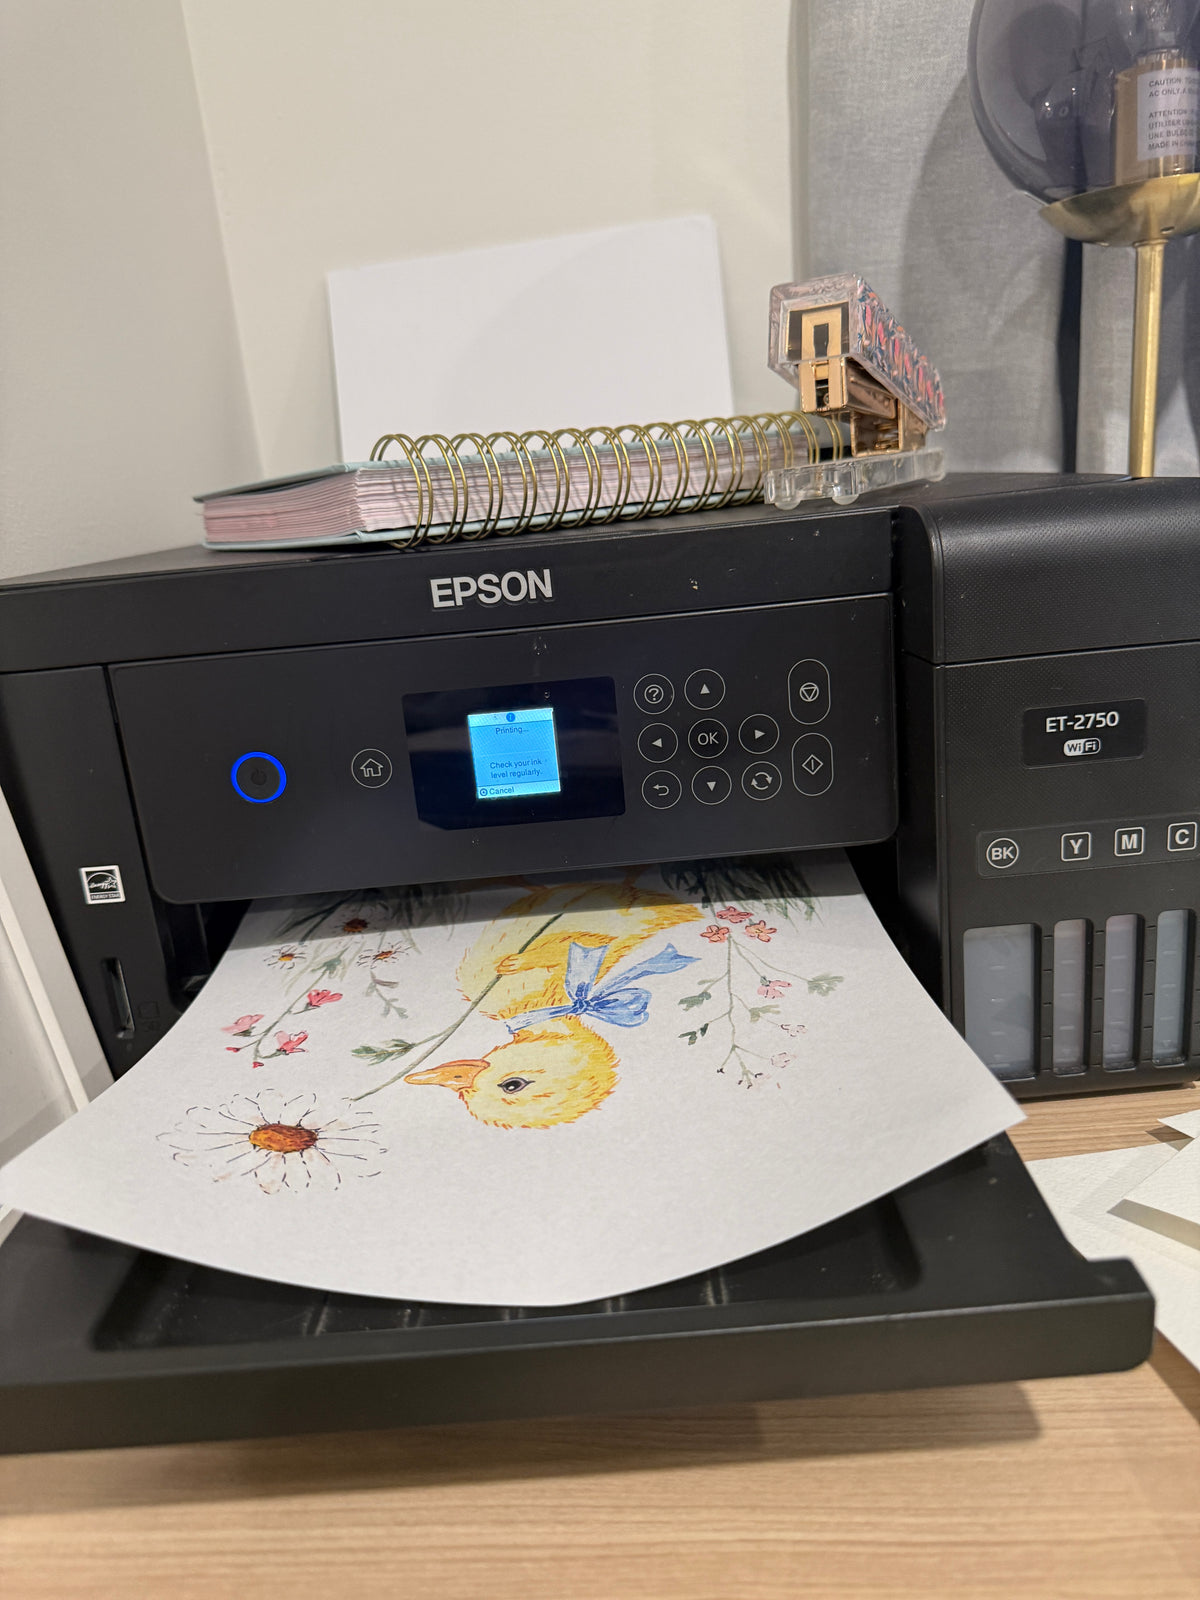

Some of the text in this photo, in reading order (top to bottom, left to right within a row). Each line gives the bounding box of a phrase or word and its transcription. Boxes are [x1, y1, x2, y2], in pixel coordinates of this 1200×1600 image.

[1148, 141, 1168, 150] MADE
[430, 568, 553, 608] EPSON
[1045, 710, 1120, 733] ET-2750
[697, 731, 719, 746] OK
[489, 758, 542, 769] Check your ink
[489, 787, 515, 795] Cancel
[991, 828, 1190, 861] BK Y M C
